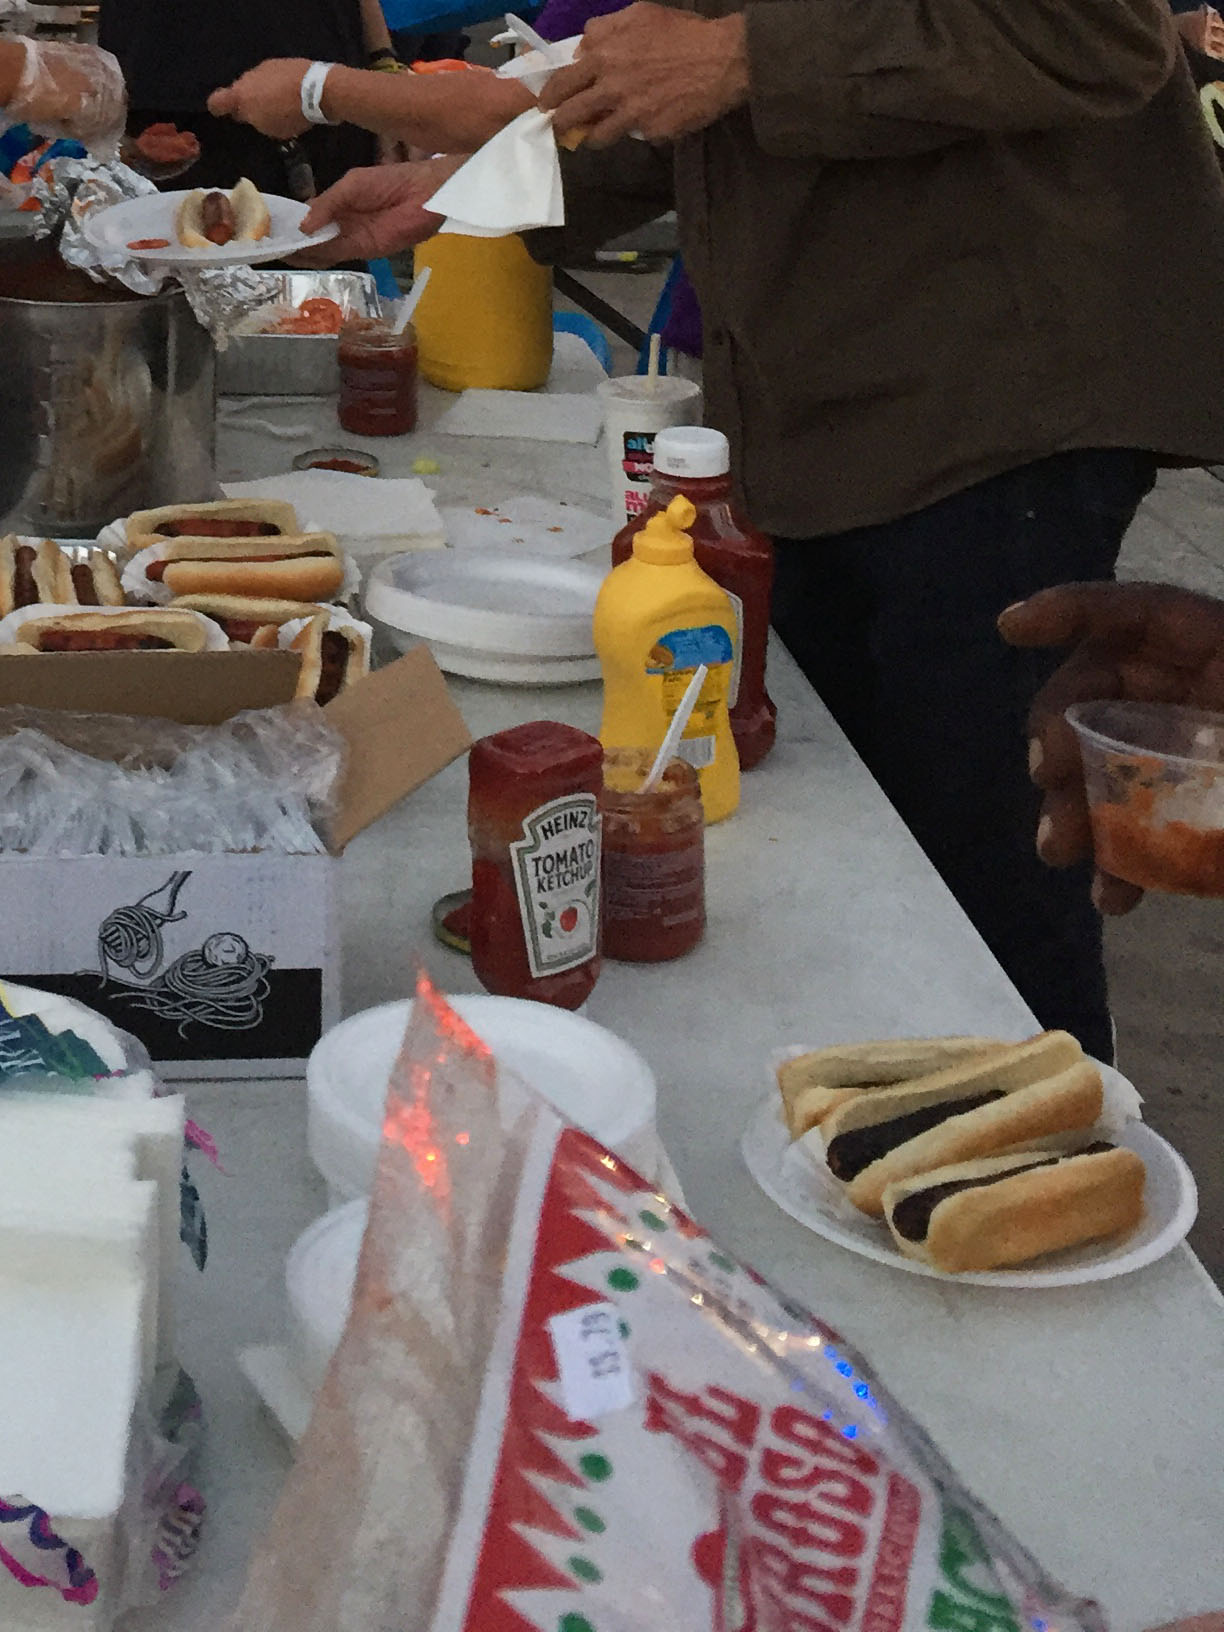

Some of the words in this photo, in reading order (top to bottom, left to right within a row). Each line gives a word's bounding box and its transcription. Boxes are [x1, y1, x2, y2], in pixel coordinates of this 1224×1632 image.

[541, 811, 588, 841] HEINZ
[532, 839, 595, 878] TOMATO
[537, 860, 594, 894] KETCHUP
